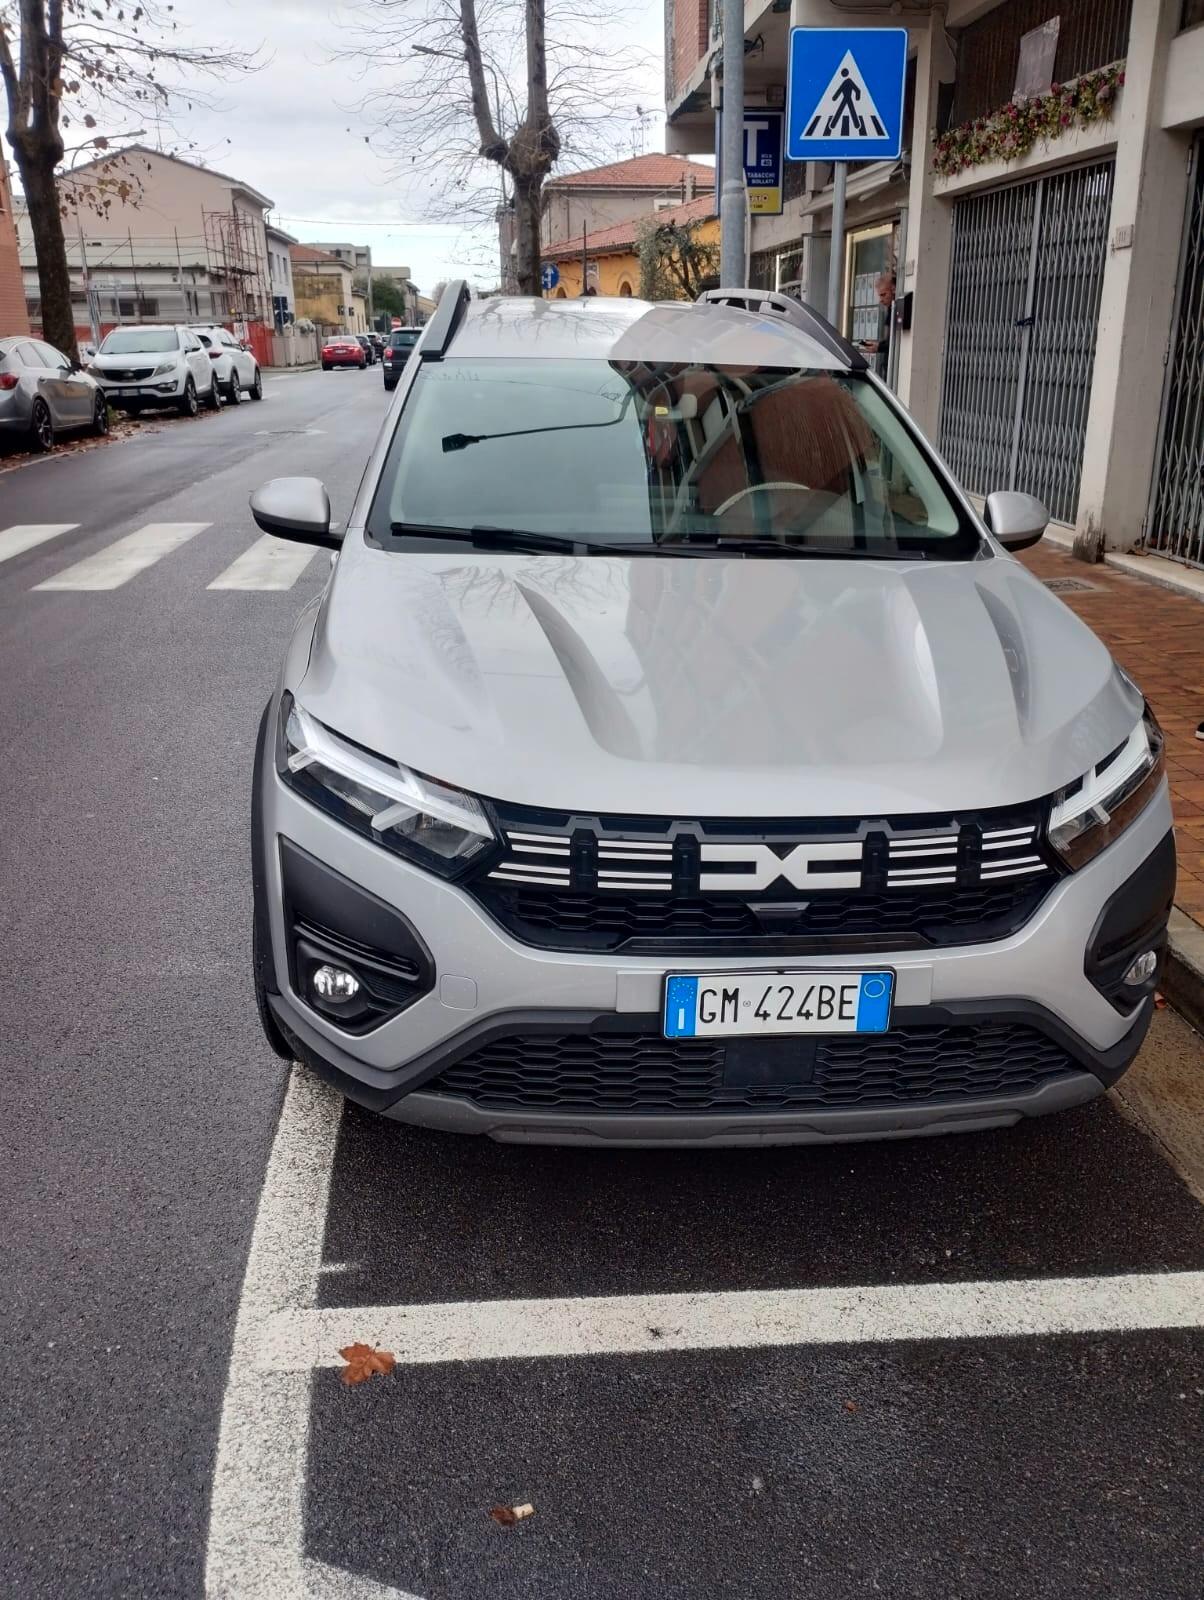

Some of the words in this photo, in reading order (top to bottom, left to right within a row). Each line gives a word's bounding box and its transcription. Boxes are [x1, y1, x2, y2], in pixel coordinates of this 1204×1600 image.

[743, 121, 768, 166] T
[699, 988, 740, 1024] GM
[754, 985, 858, 1022] 424BE
